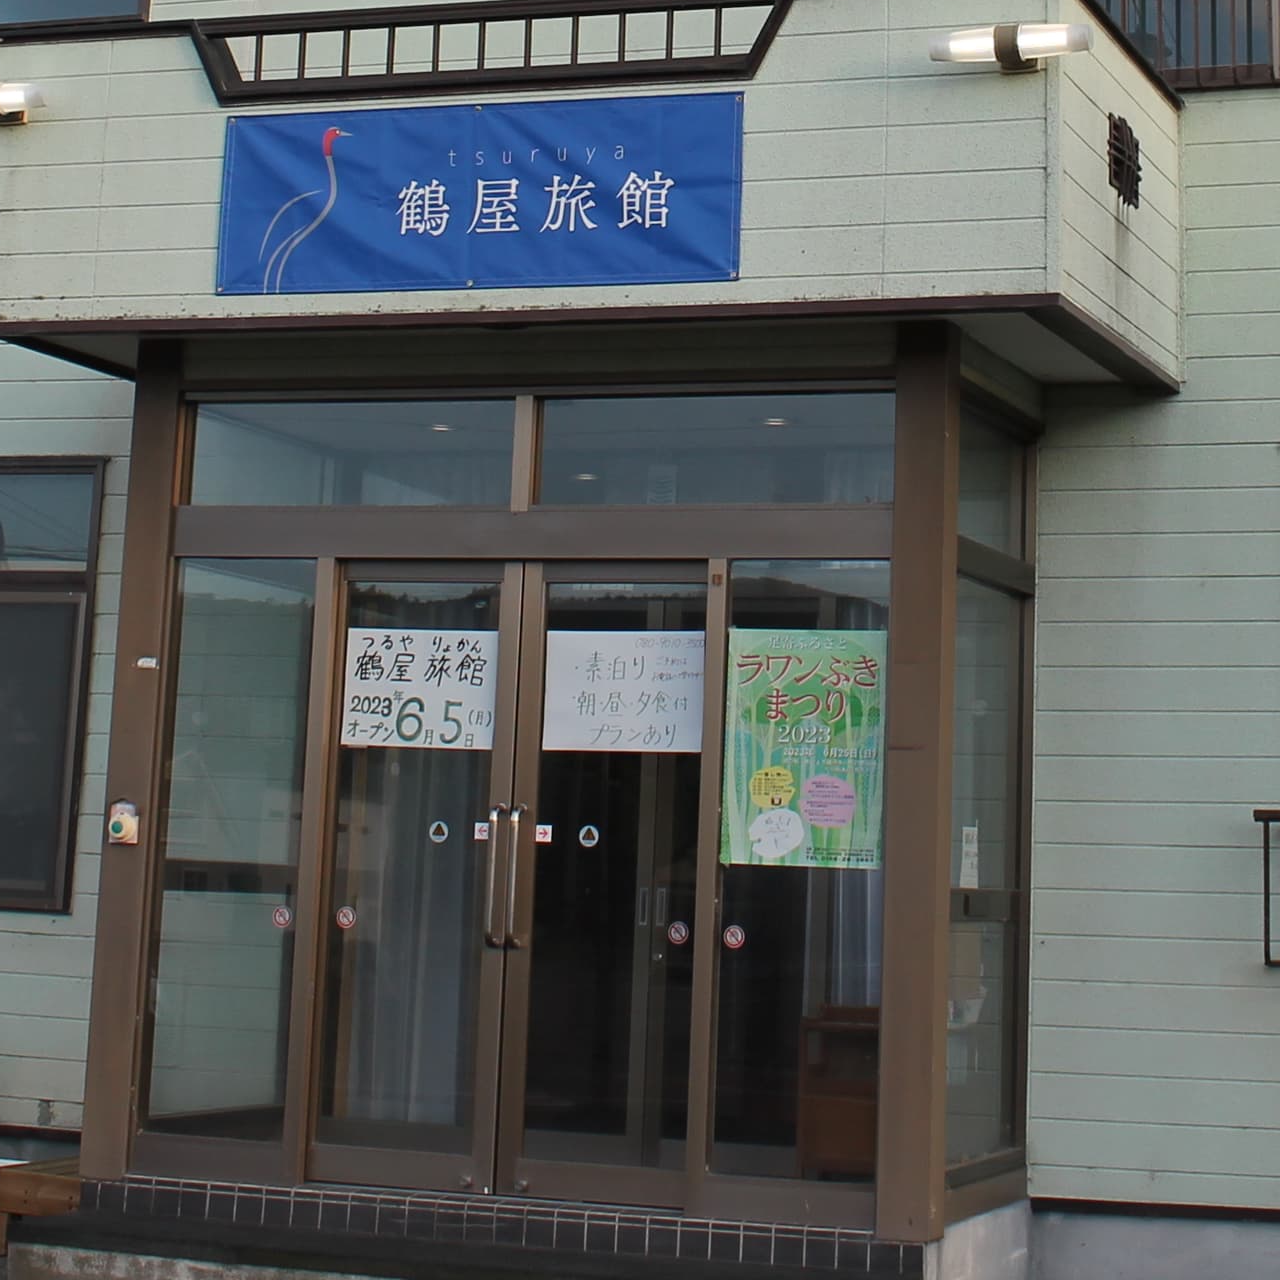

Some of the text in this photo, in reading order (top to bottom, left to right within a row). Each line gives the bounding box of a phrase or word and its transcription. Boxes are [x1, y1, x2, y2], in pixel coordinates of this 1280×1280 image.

[448, 144, 626, 167] tsuruya
[396, 171, 676, 236] 鶴屋旅館
[363, 635, 482, 653] つるや りょかん
[355, 650, 488, 687] 鶴屋 旅館
[736, 654, 880, 688] ラワンぶき
[765, 688, 847, 723] まつり
[346, 719, 395, 743] オープン
[589, 723, 677, 748] プランあり
[777, 725, 832, 744] 2023
